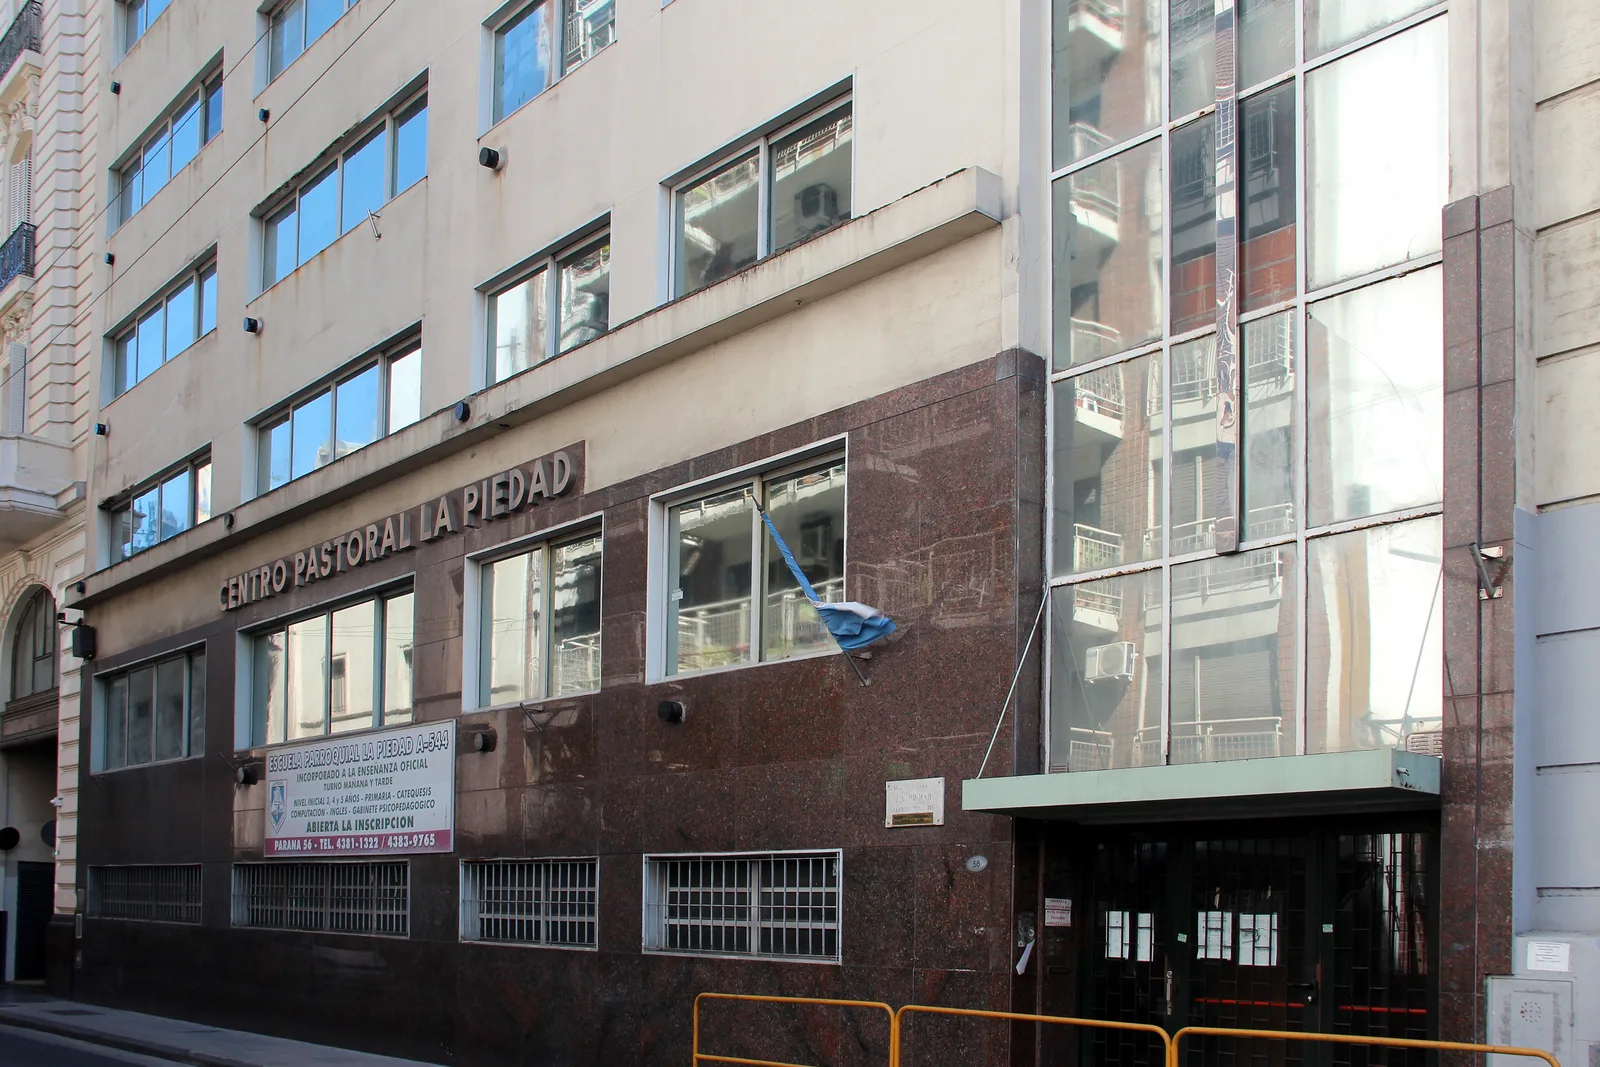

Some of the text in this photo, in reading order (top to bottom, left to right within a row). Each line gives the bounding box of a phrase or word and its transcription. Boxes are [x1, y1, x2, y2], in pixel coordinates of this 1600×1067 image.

[218, 451, 574, 611] CENTRO PASTORAL LA PIEDAD
[269, 729, 449, 772] ESCUELA PARROQUIAL LA PIEDAD A-544
[297, 758, 428, 783] INCORPORADO A LA ENSEÑANZA OFICIAL
[323, 782, 342, 791] TURNO
[343, 778, 369, 790] MAÑANA
[375, 777, 393, 786] TARDE
[293, 798, 307, 807] NIVEL
[307, 797, 325, 806] INICIAL
[345, 792, 360, 803] AÑOS
[364, 792, 391, 802] PRIMARIA
[396, 787, 432, 799] CATEQUESIS
[290, 808, 325, 819] COMPUTACION
[329, 807, 348, 816] INGLES
[352, 805, 378, 815] GABINETE
[379, 799, 436, 813] PSICOPEDAGOGICO
[306, 816, 414, 833] ABIERTA LA INSCRIPCION
[274, 839, 301, 851] PARANA
[302, 838, 312, 851] 56
[319, 838, 334, 850] TEL.
[336, 836, 379, 850] 4381-1322
[387, 833, 436, 848] 4383-9765
